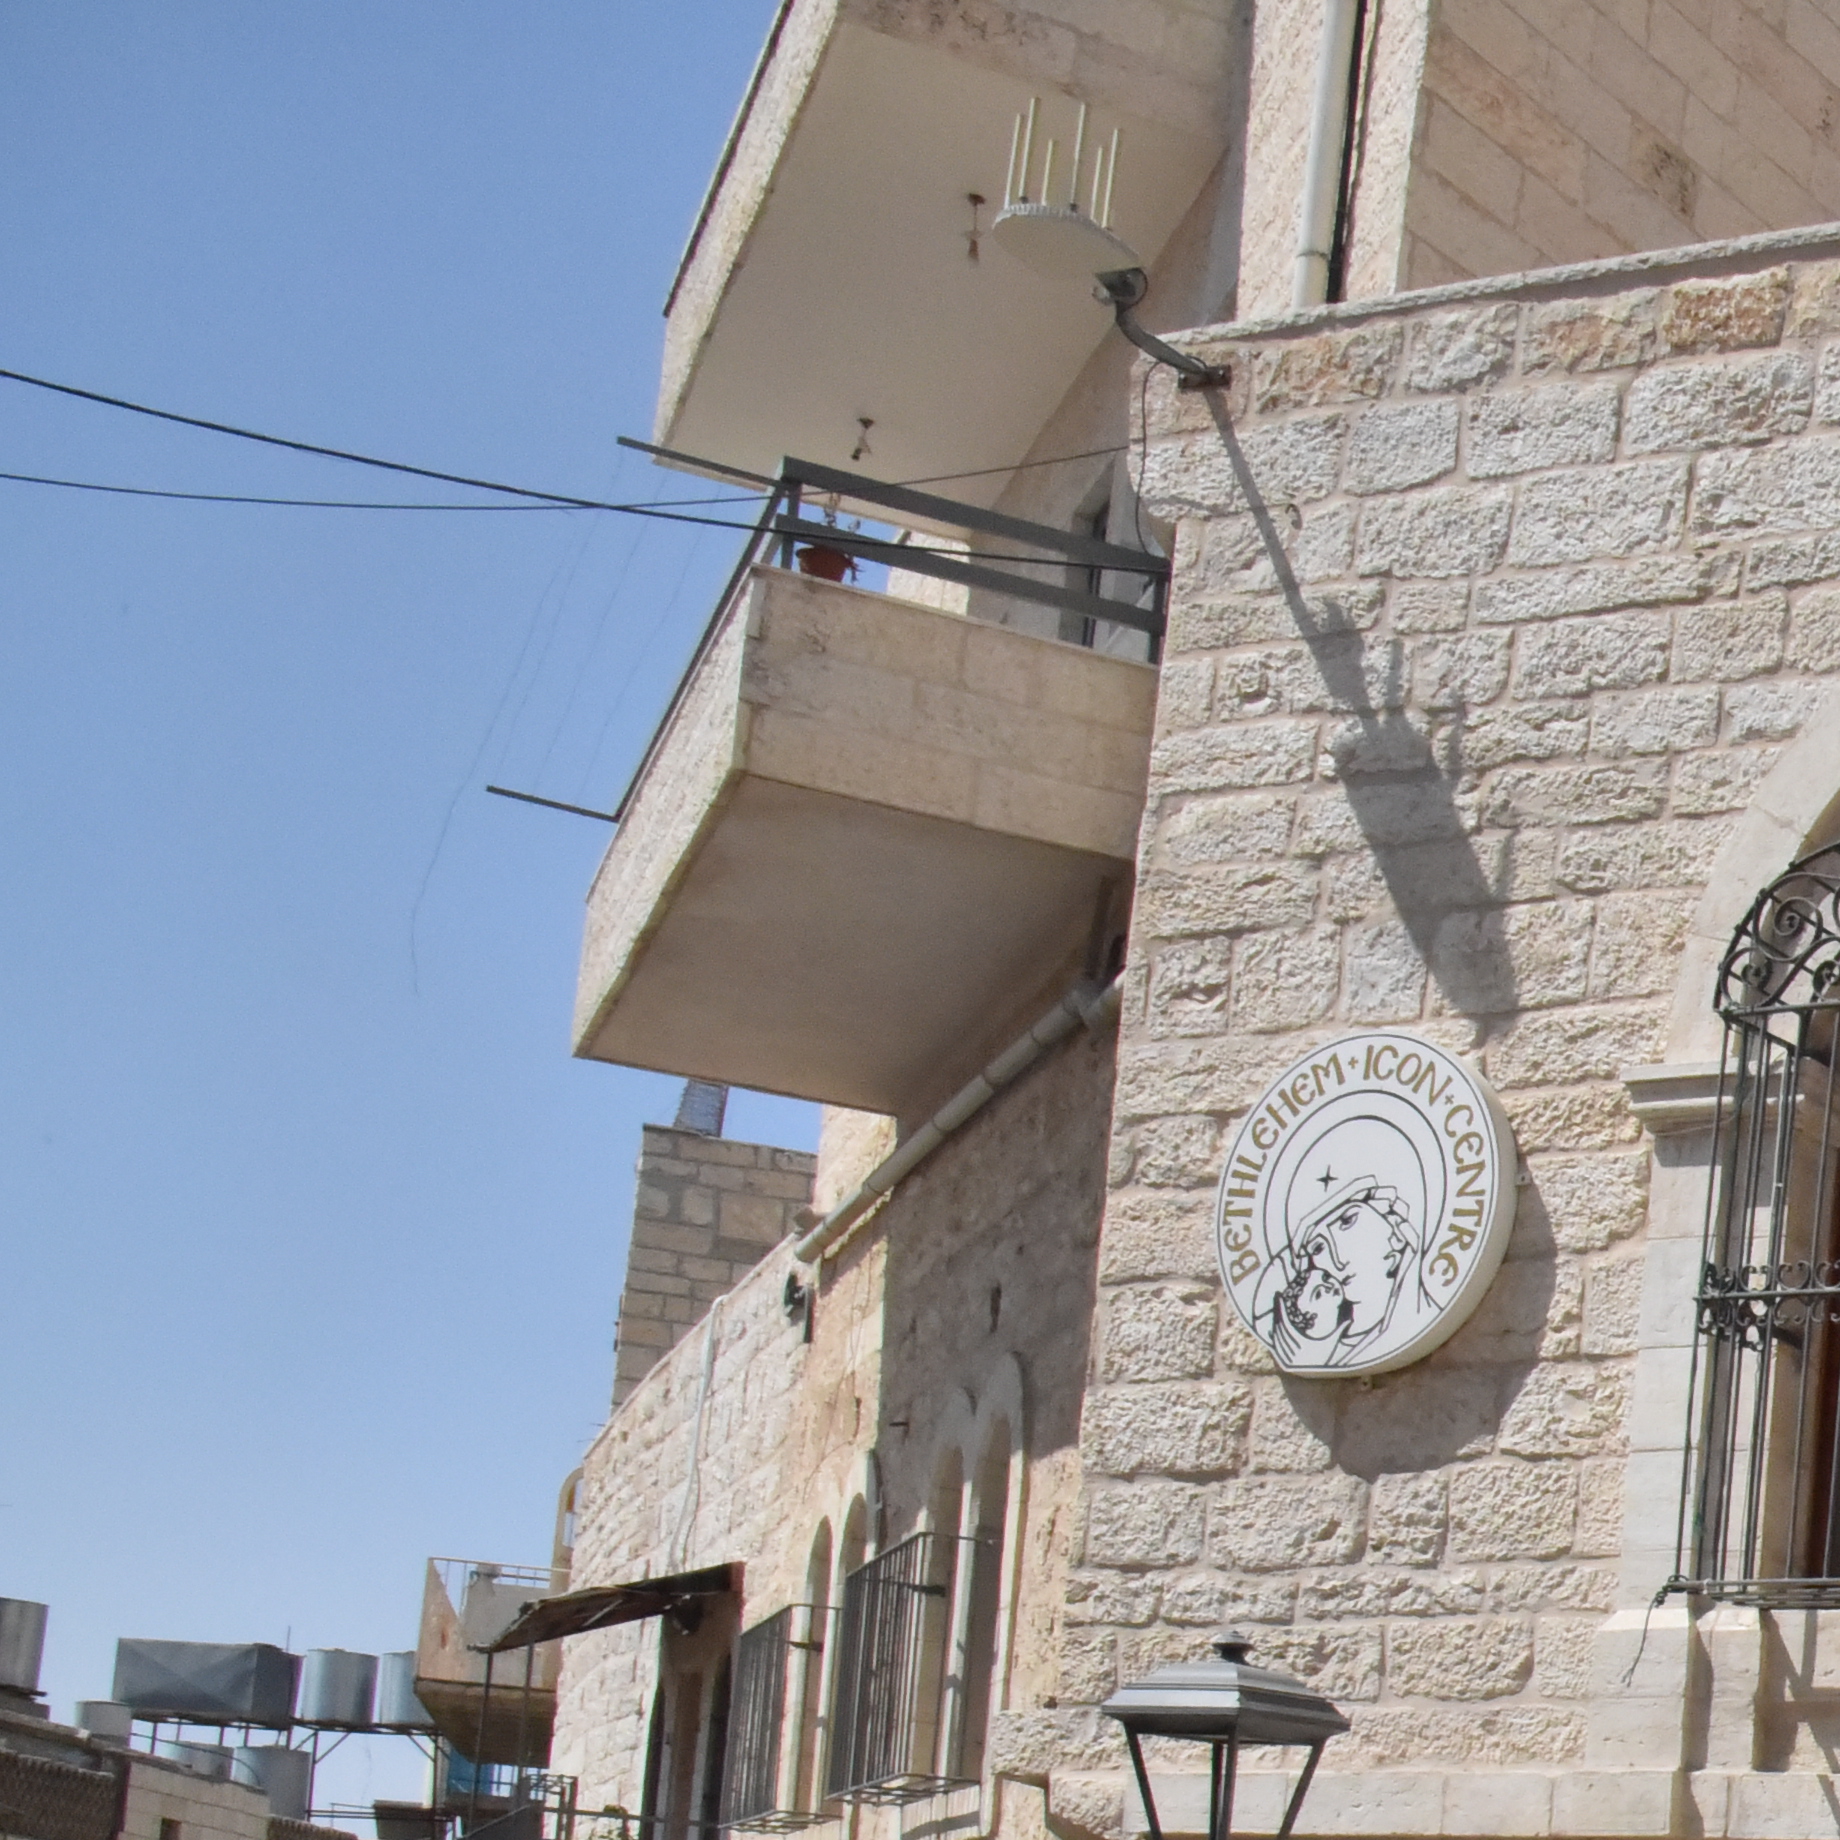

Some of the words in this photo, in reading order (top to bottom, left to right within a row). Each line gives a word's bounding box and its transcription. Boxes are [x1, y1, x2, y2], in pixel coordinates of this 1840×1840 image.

[1223, 1053, 1345, 1286] BETHLEHEM
[1362, 1044, 1452, 1107] ICON
[1428, 1103, 1486, 1287] CENTRE
